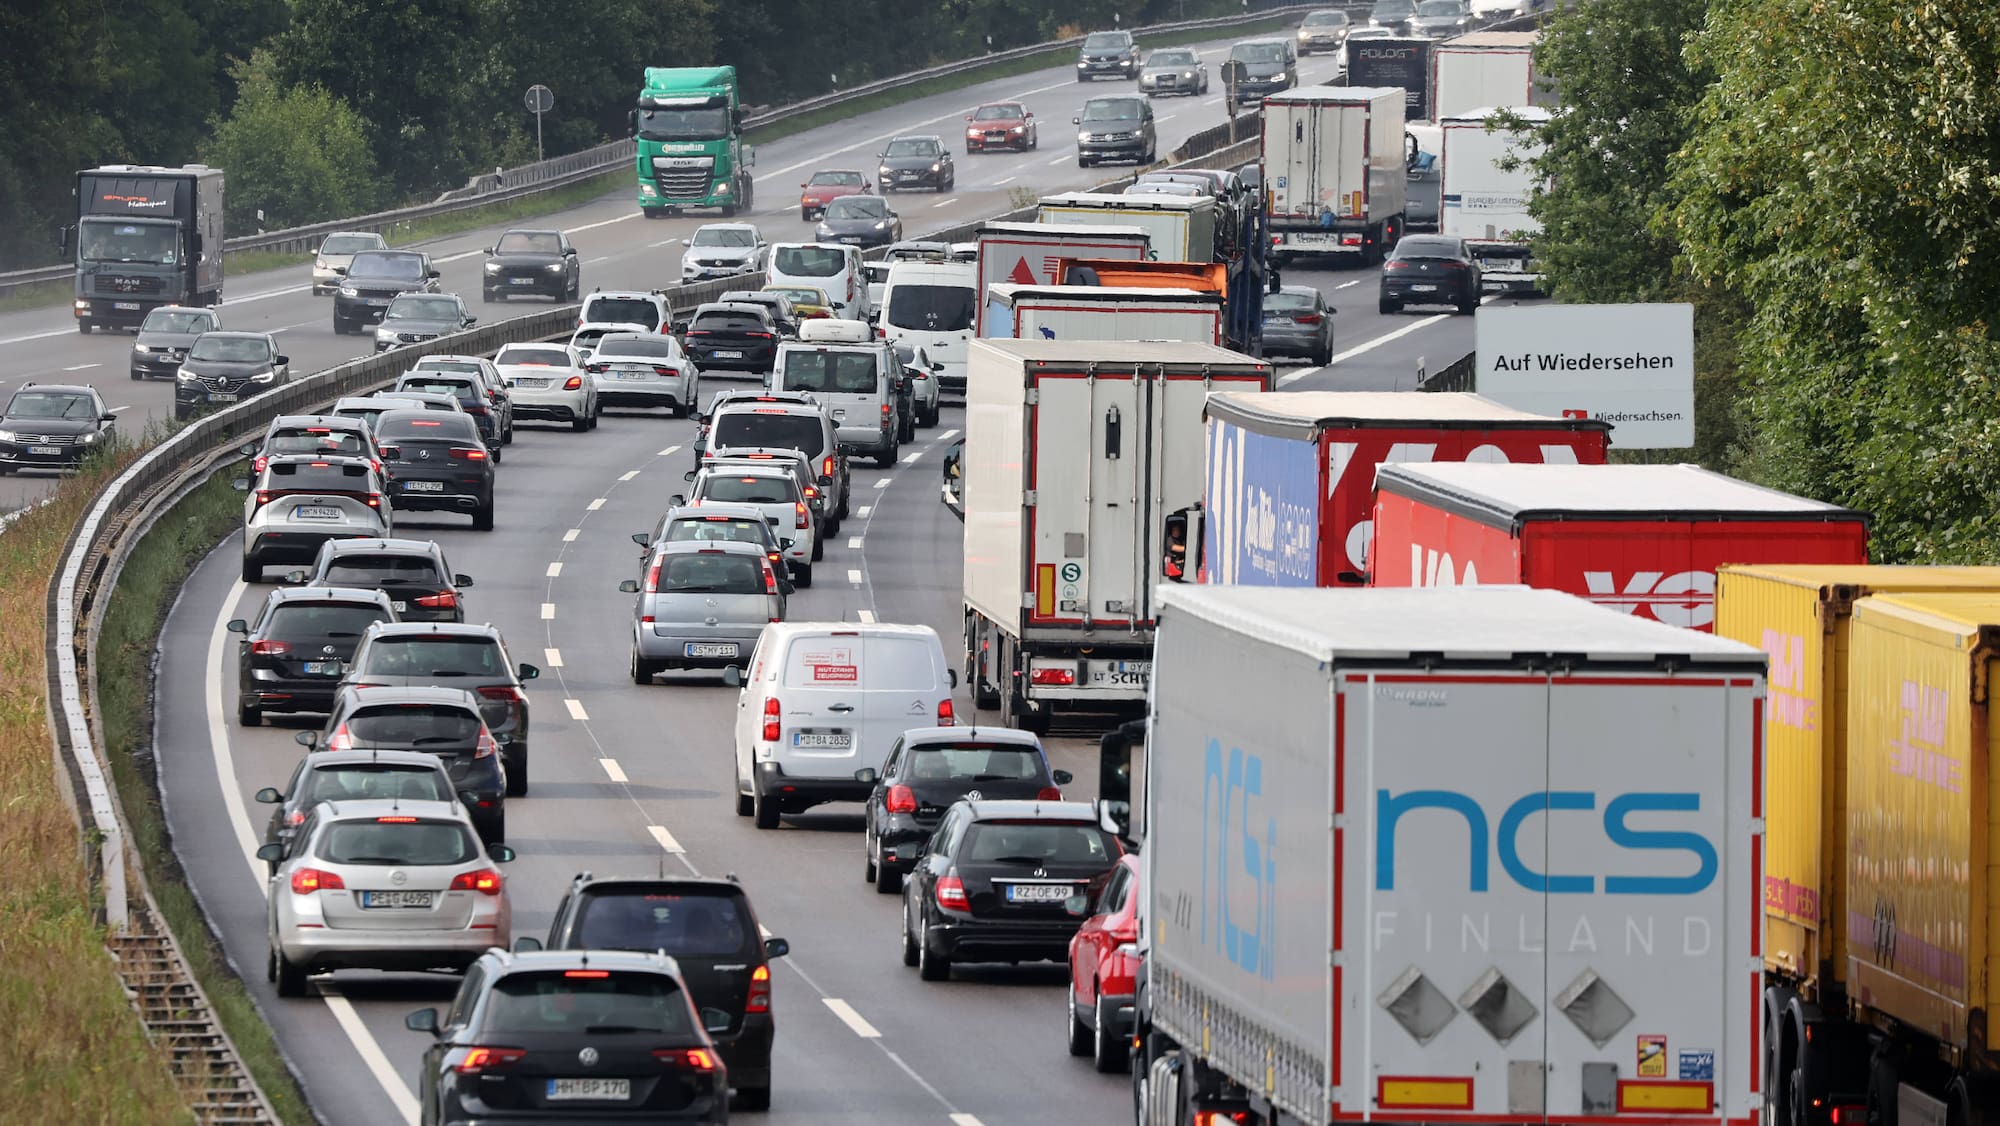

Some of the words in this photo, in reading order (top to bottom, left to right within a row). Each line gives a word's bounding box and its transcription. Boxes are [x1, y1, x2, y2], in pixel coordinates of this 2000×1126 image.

[115, 277, 140, 286] MAN
[1494, 353, 1531, 372] Auf
[1537, 352, 1673, 371] Wiedersehen
[1064, 564, 1079, 581] S
[693, 646, 703, 655] RS
[720, 646, 734, 655] 111
[1094, 673, 1105, 681] LT
[800, 734, 811, 746] MD
[816, 734, 827, 746] BA
[828, 734, 849, 746] 2835
[1376, 789, 1719, 895] ncs
[1016, 886, 1030, 897] RZ
[1054, 886, 1068, 897] 99
[1374, 912, 1712, 956] FINLAND
[555, 1081, 574, 1096] HH
[580, 1081, 600, 1096] BP
[603, 1081, 628, 1096] 170
